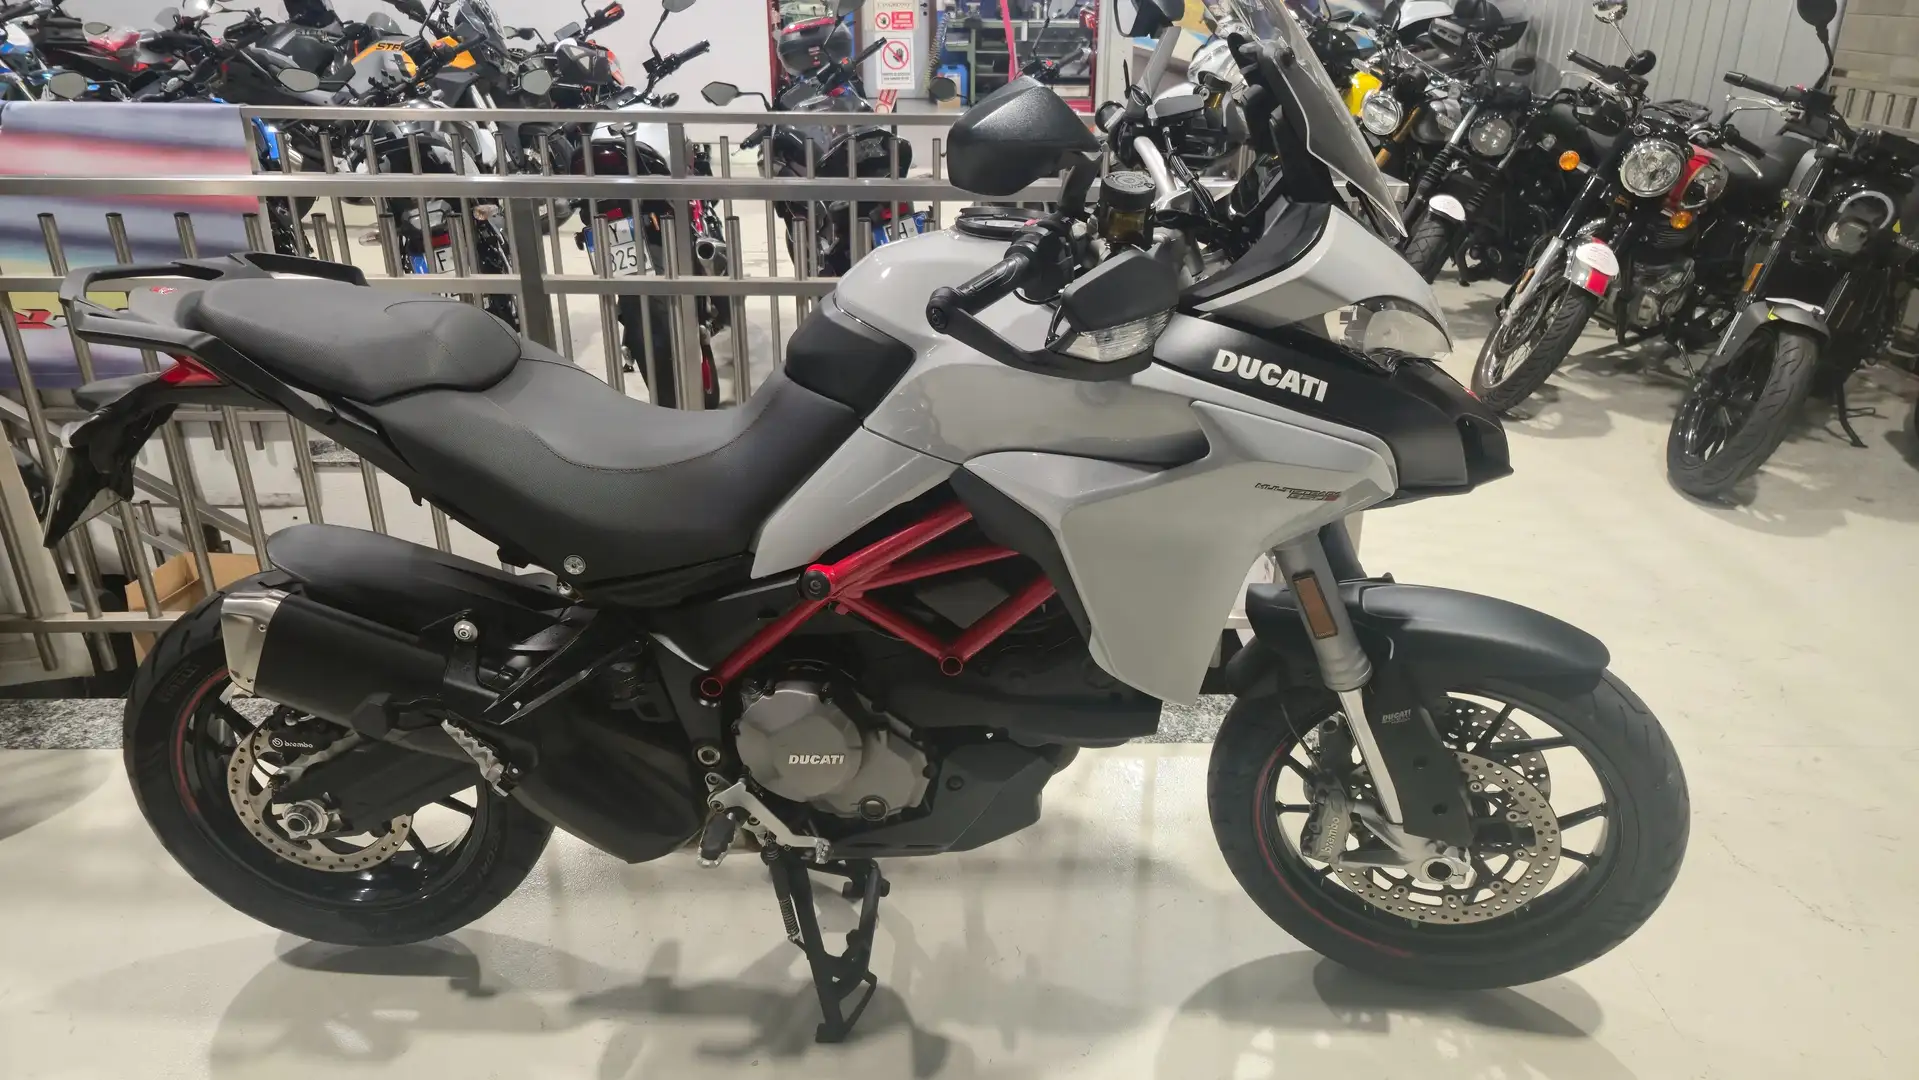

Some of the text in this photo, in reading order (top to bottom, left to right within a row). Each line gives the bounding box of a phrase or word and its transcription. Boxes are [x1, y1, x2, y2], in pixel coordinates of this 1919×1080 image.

[1212, 348, 1328, 402] DUCATI
[1382, 708, 1412, 721] DUCATI
[284, 740, 314, 749] brembo
[788, 754, 845, 765] DUCATI
[1321, 817, 1340, 854] brembo
